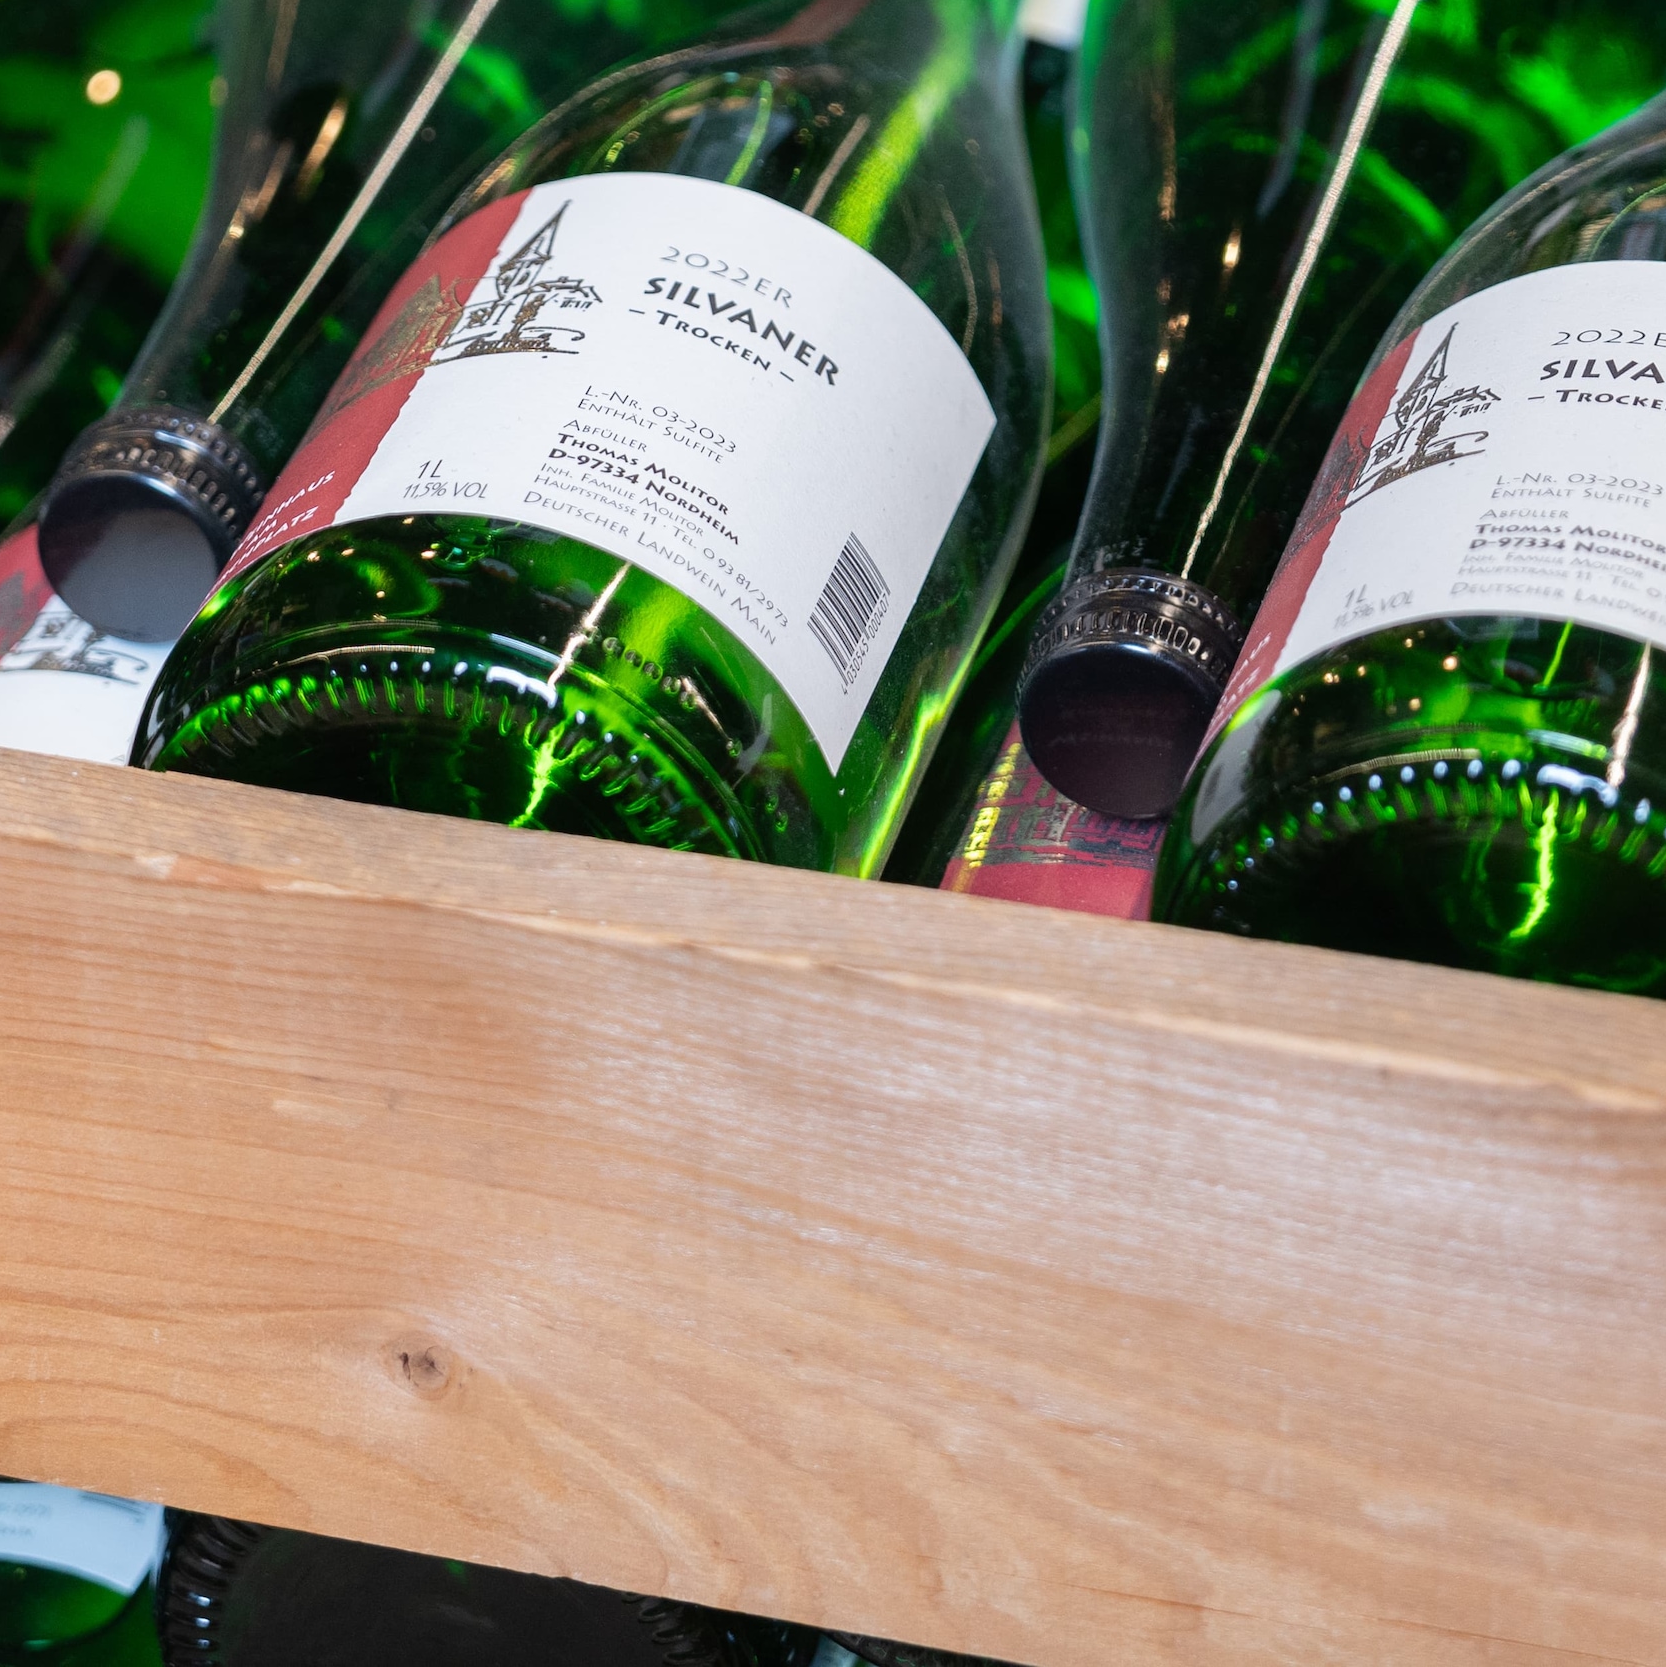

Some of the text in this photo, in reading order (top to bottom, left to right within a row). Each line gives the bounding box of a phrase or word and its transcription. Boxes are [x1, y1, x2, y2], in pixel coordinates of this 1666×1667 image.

[660, 245, 793, 309] 2022ER
[643, 276, 840, 387] SILVANER
[656, 309, 771, 371] TROCKEN
[563, 419, 648, 453] ABFÜLLER
[651, 405, 737, 454] 03-2023
[662, 425, 724, 465] SULFITE
[452, 482, 489, 499] VOL
[533, 474, 638, 517] HAUPTSTRASSE
[548, 447, 740, 546] D-97334 NORDHEIM
[557, 432, 730, 516] THOMAS MOLITOR
[1582, 487, 1652, 509] SULFITE
[580, 472, 636, 501] FAMILIE
[638, 496, 704, 537] MOLITOR
[1475, 522, 1563, 535] THOMAS
[523, 490, 778, 646] DEUTSCHER LANDWEIN MAIN
